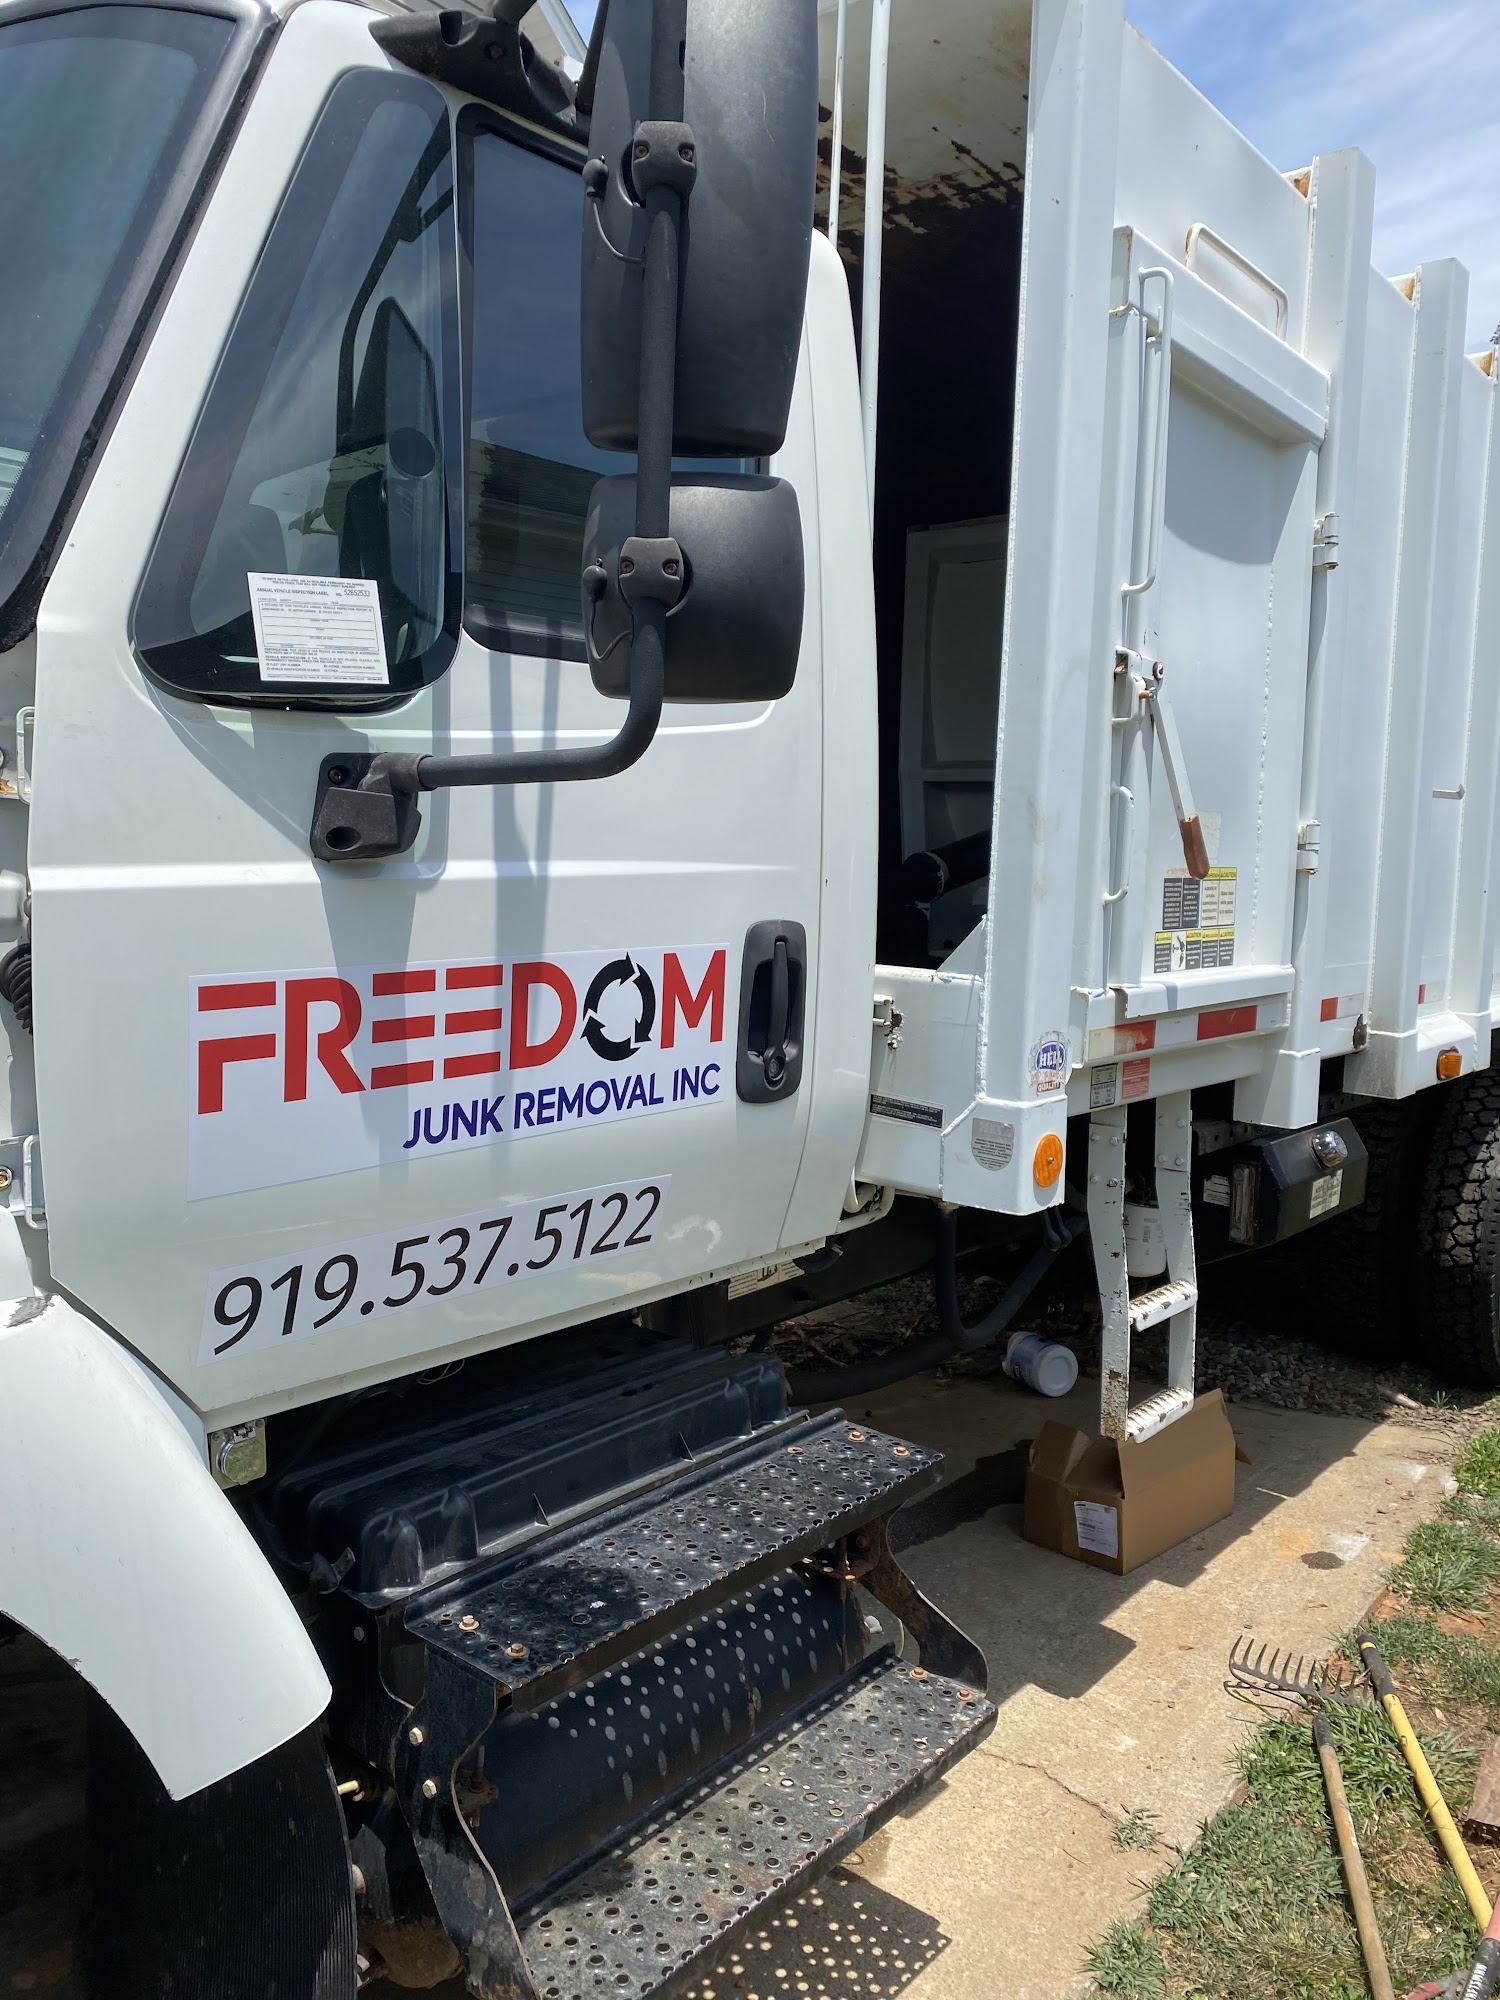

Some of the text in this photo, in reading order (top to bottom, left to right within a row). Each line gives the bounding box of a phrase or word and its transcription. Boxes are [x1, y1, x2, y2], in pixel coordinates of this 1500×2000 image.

[197, 949, 727, 1115] FREEDOM
[402, 1062, 721, 1149] JUNK REMOVAL INC
[213, 1184, 661, 1356] 919.537.5122
